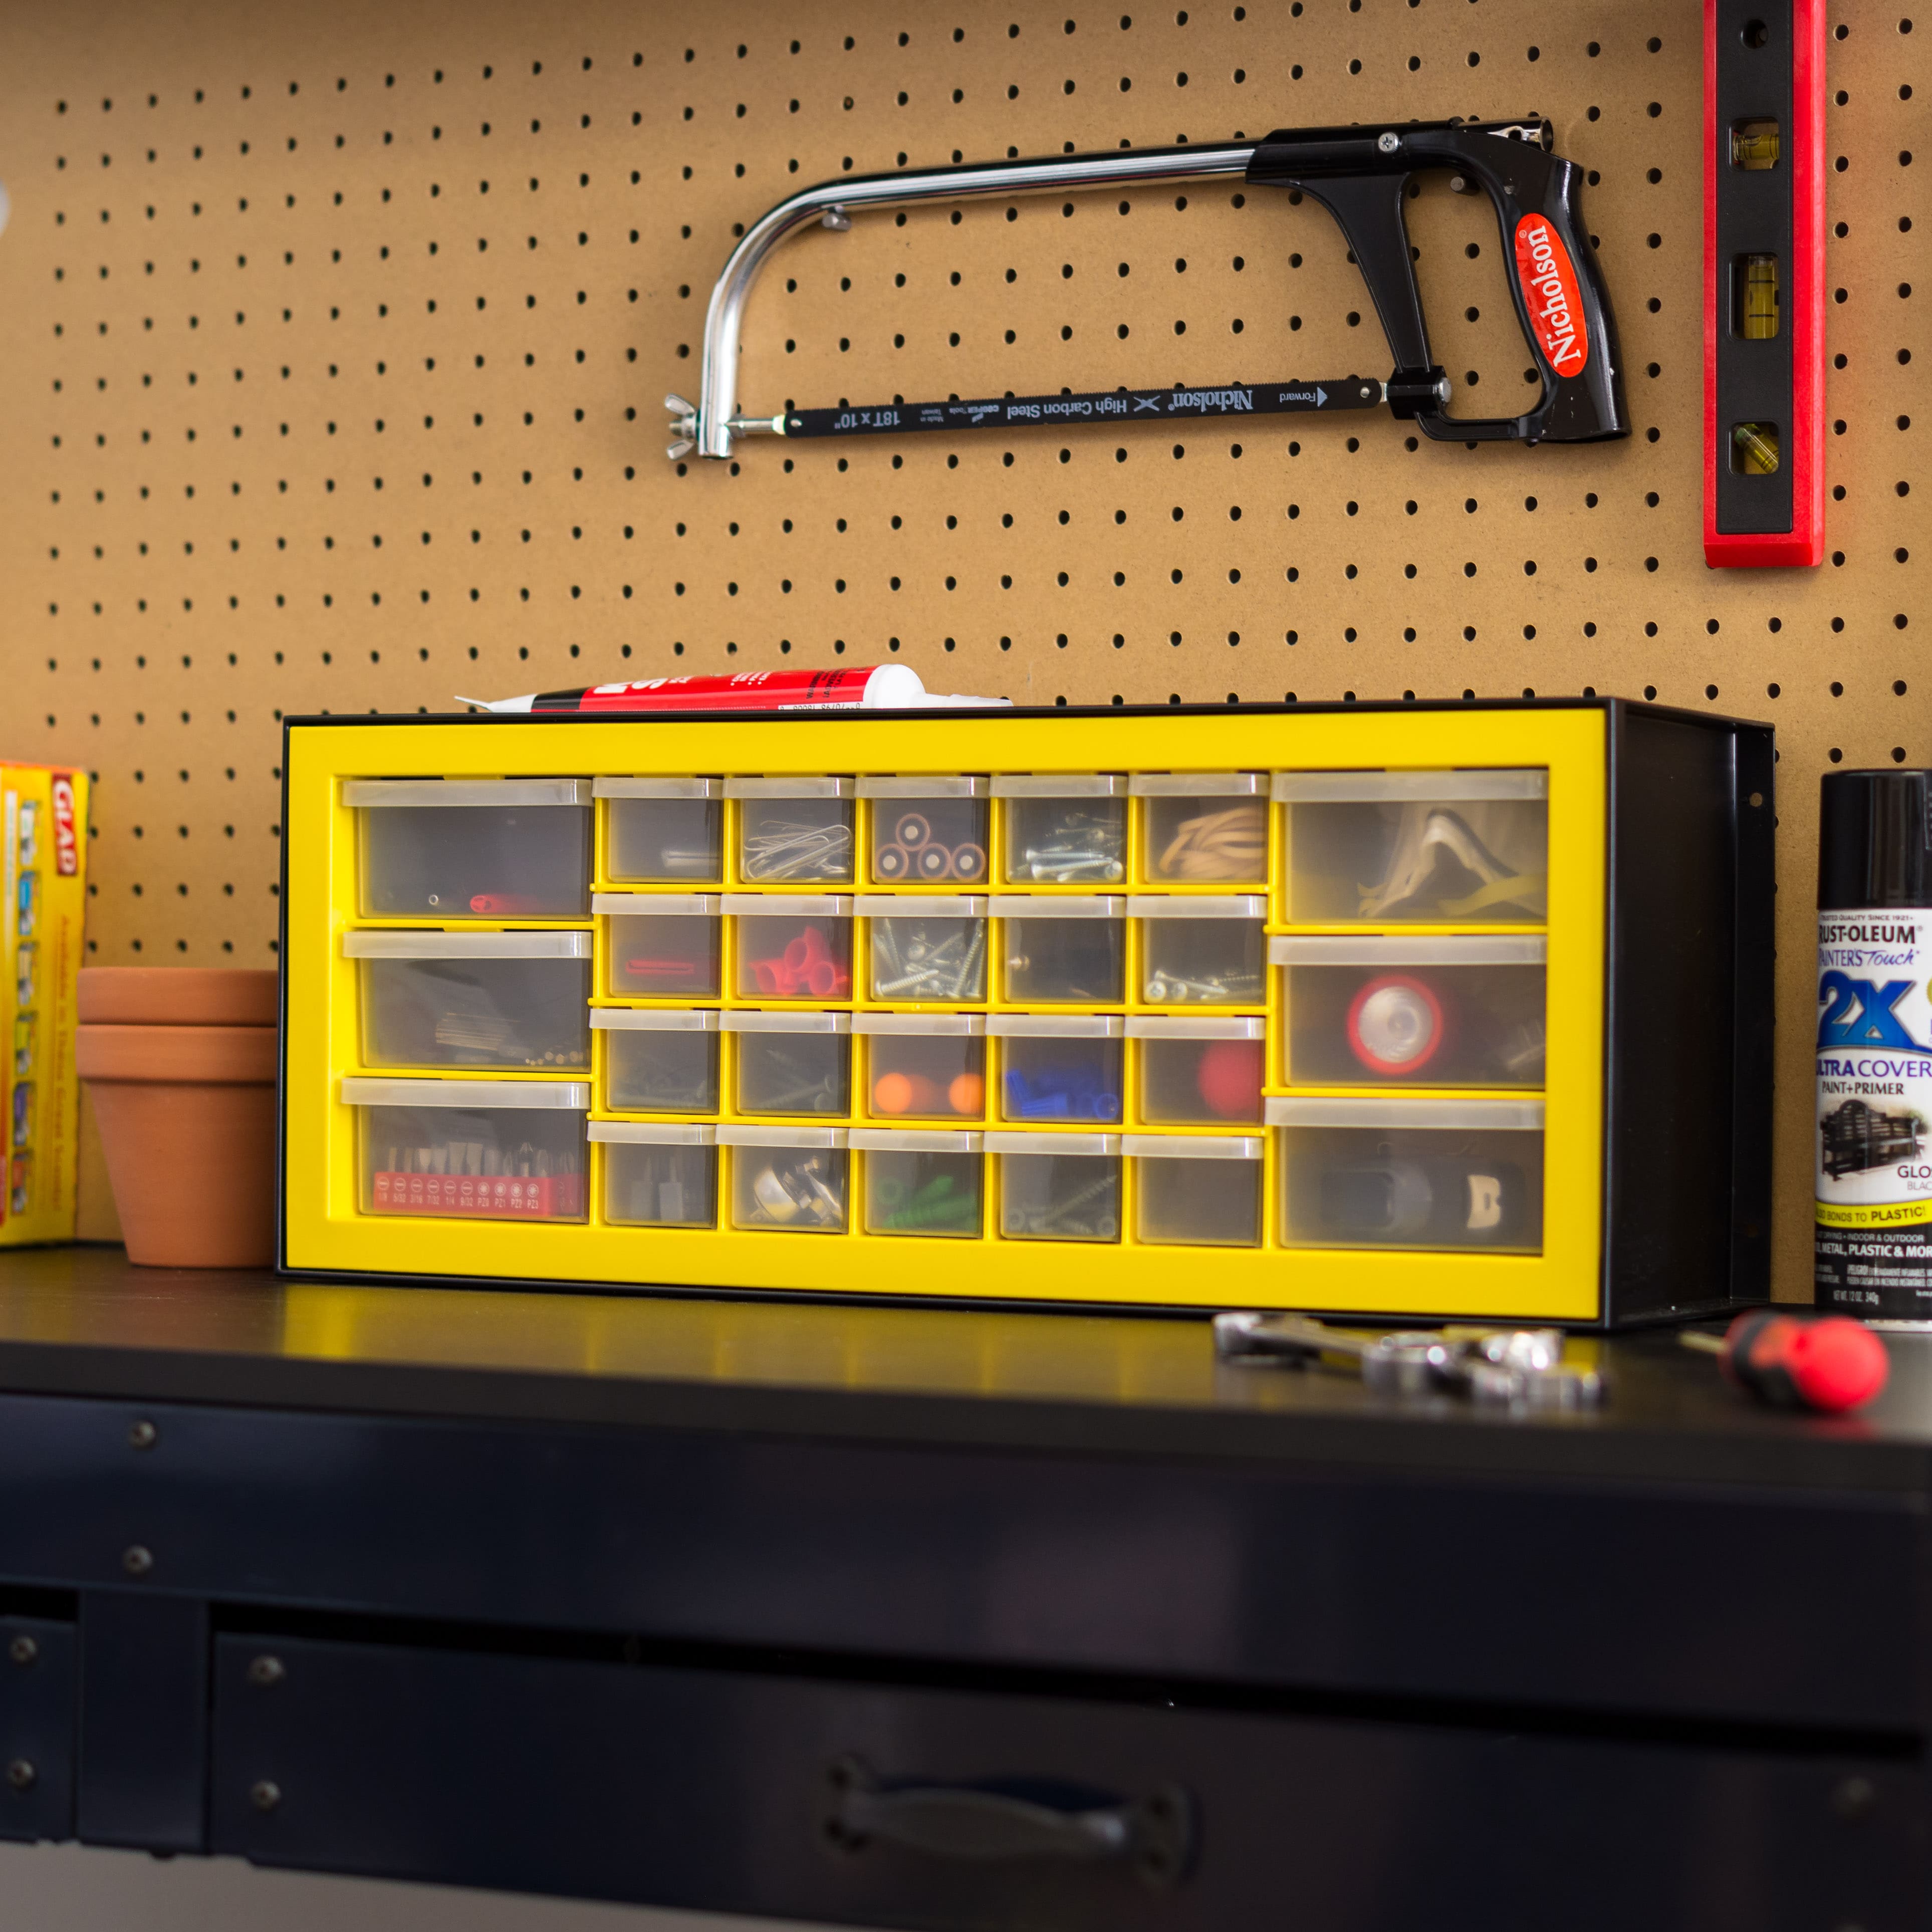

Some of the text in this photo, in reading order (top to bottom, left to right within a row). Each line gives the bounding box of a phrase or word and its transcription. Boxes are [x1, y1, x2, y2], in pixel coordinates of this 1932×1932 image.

[1528, 225, 1581, 367] Nicholson
[1172, 390, 1253, 412] Nicholson
[1280, 392, 1315, 403] Forward
[1007, 397, 1126, 419] High Carbon Steel
[860, 413, 871, 424] x
[873, 411, 900, 427] 18T
[53, 779, 76, 874] GLAD
[1861, 948, 1914, 966] Touch
[1818, 970, 1917, 1046] 2X
[1897, 1165, 1932, 1178] GLO
[1827, 1211, 1852, 1222] BONDS
[1855, 1213, 1867, 1222] TO
[1871, 1205, 1926, 1221] PLASTIC!
[1847, 1233, 1875, 1242] INDOOR
[1883, 1234, 1924, 1243] OUTDOOR
[1849, 1244, 1892, 1257] PLASTIC
[1894, 1246, 1904, 1258] &
